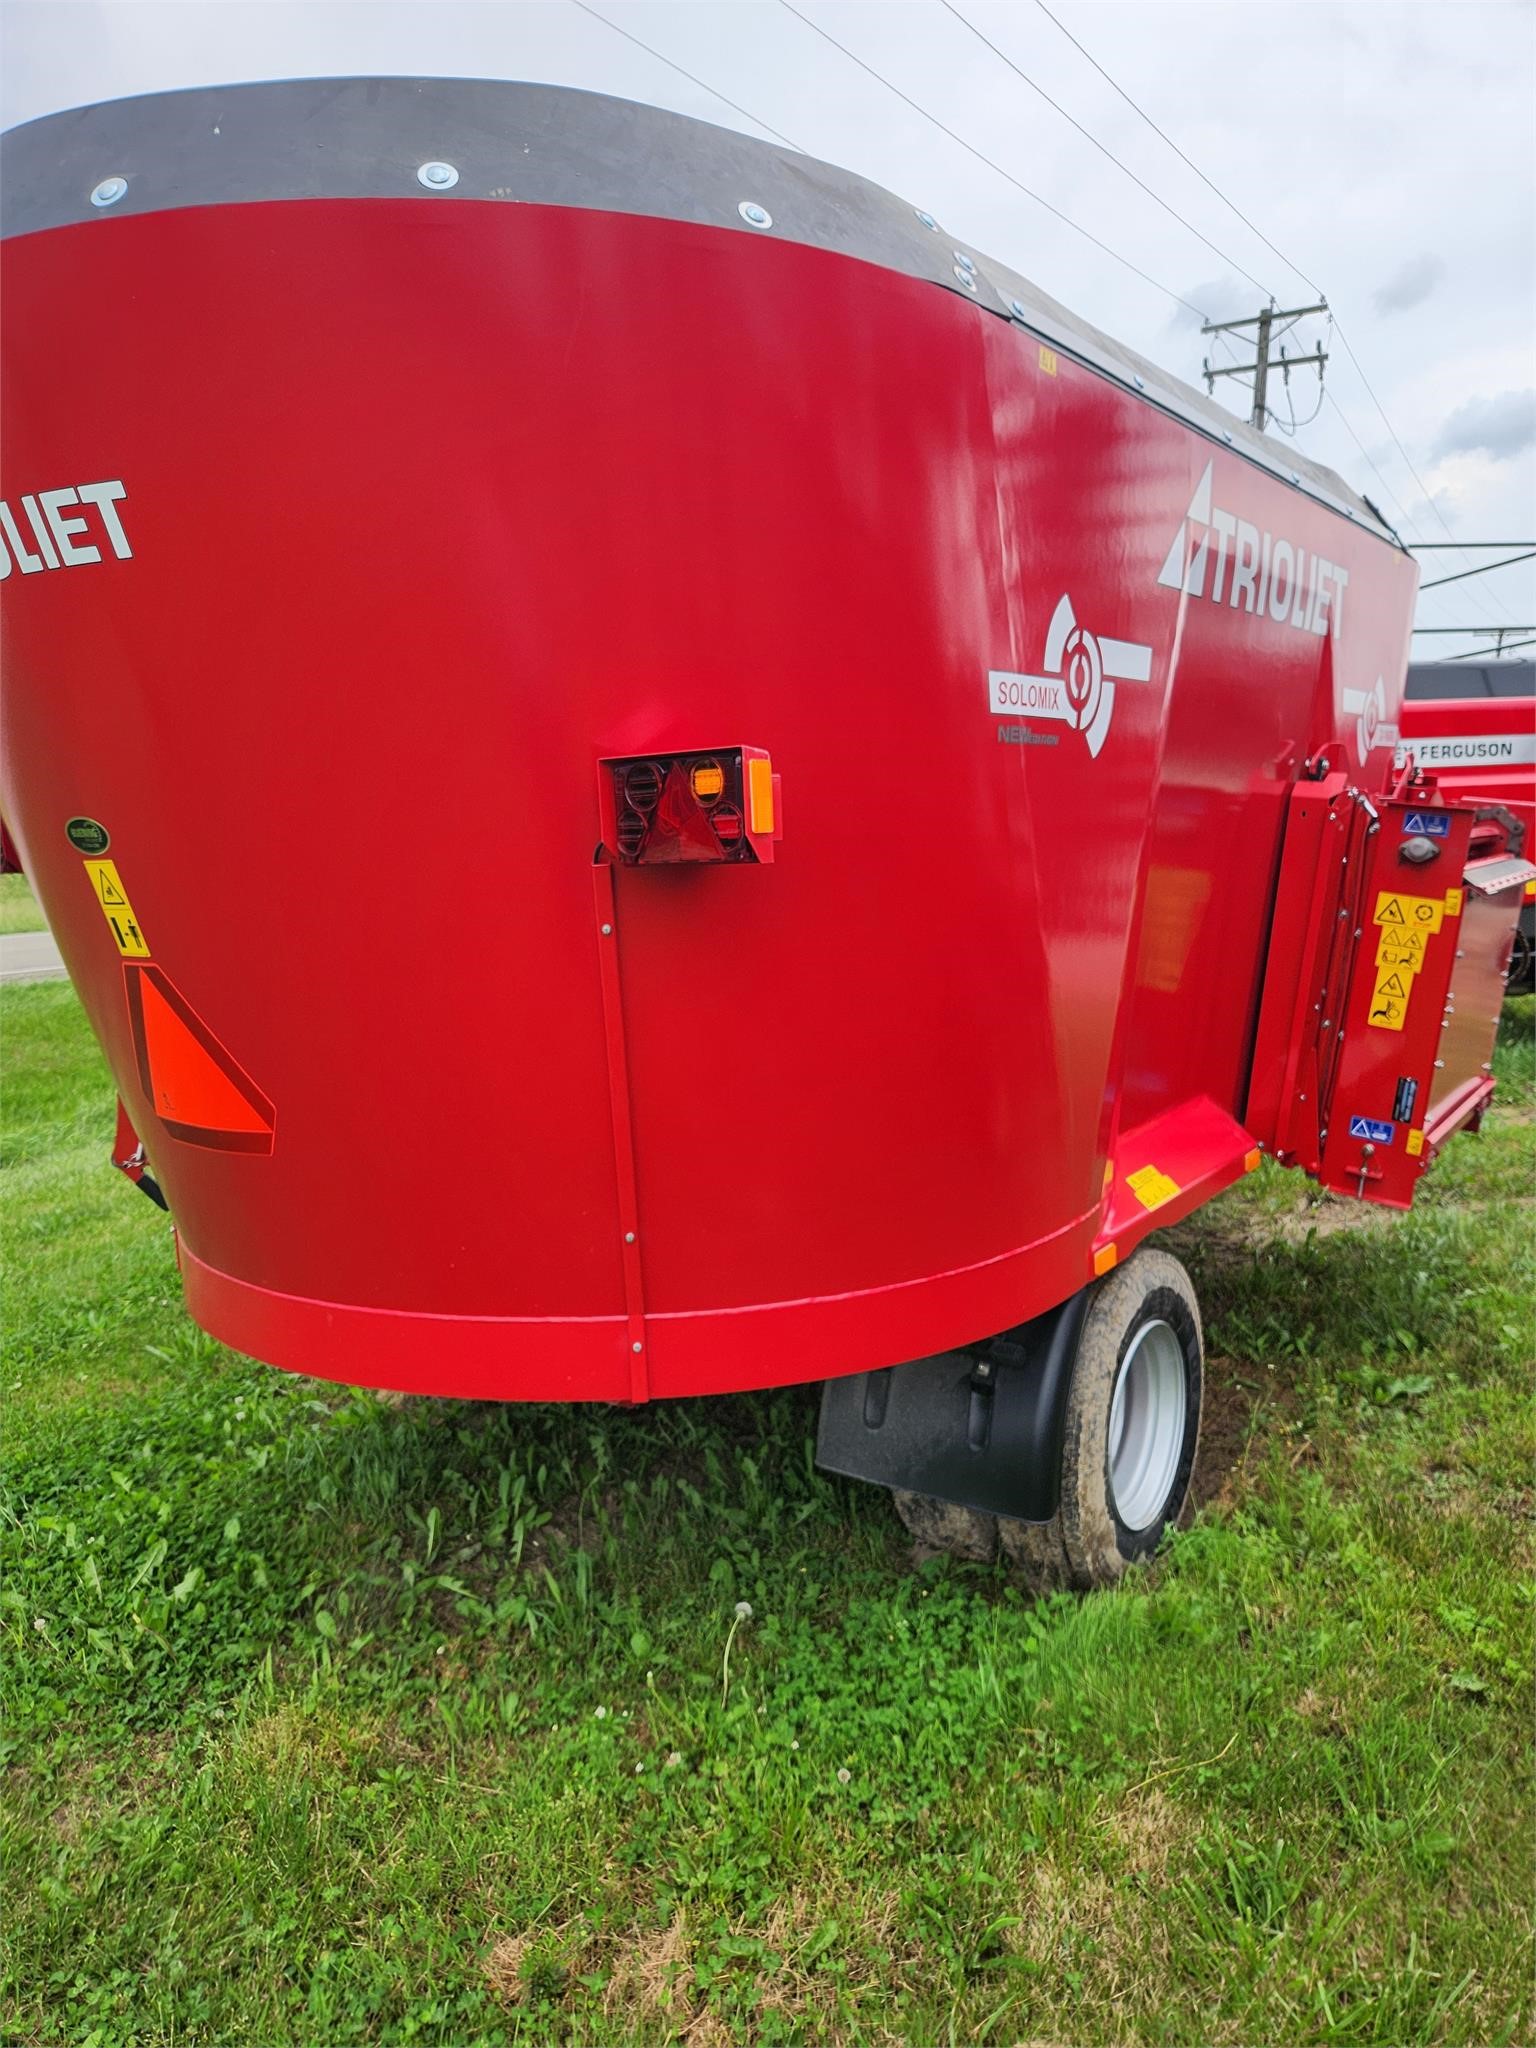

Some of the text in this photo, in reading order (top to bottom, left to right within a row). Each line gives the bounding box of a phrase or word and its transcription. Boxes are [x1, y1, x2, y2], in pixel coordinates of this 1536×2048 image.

[0, 480, 133, 581] LIET
[1211, 506, 1349, 641] TRIOLIET
[997, 681, 1060, 711] SOLOMIX
[1420, 743, 1512, 759] FERGUSON
